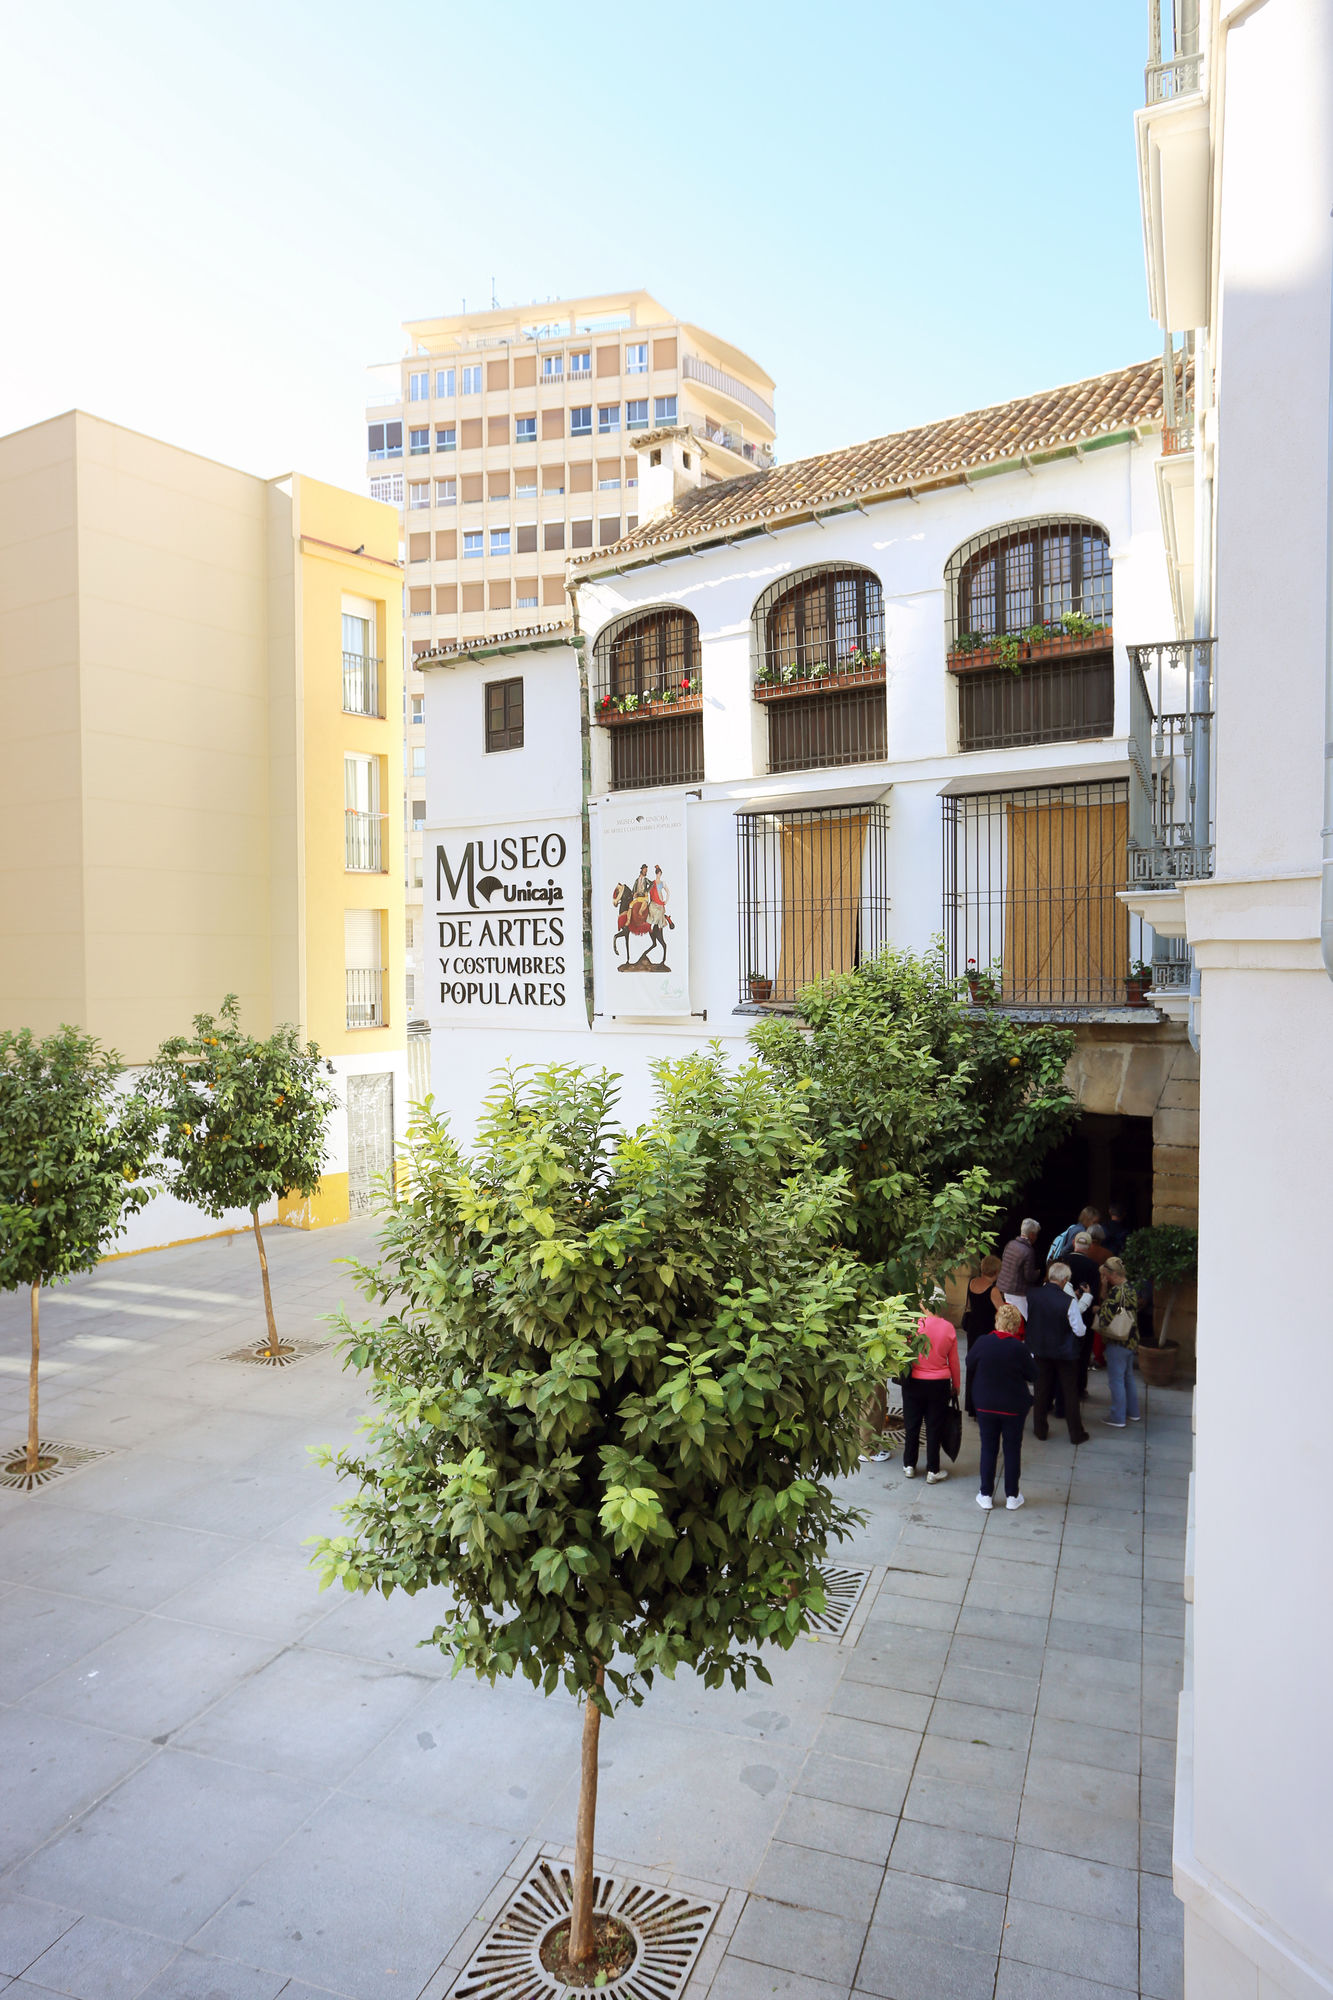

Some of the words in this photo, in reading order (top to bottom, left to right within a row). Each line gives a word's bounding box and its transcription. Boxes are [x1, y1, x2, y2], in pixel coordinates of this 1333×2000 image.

[436, 833, 567, 909] MUSEO
[503, 879, 564, 905] Unicaja
[438, 920, 473, 948] DE
[478, 917, 565, 947] ARTES
[439, 957, 450, 975] Y
[453, 956, 566, 977] COSTUMBRES
[440, 981, 566, 1007] POPULARES
